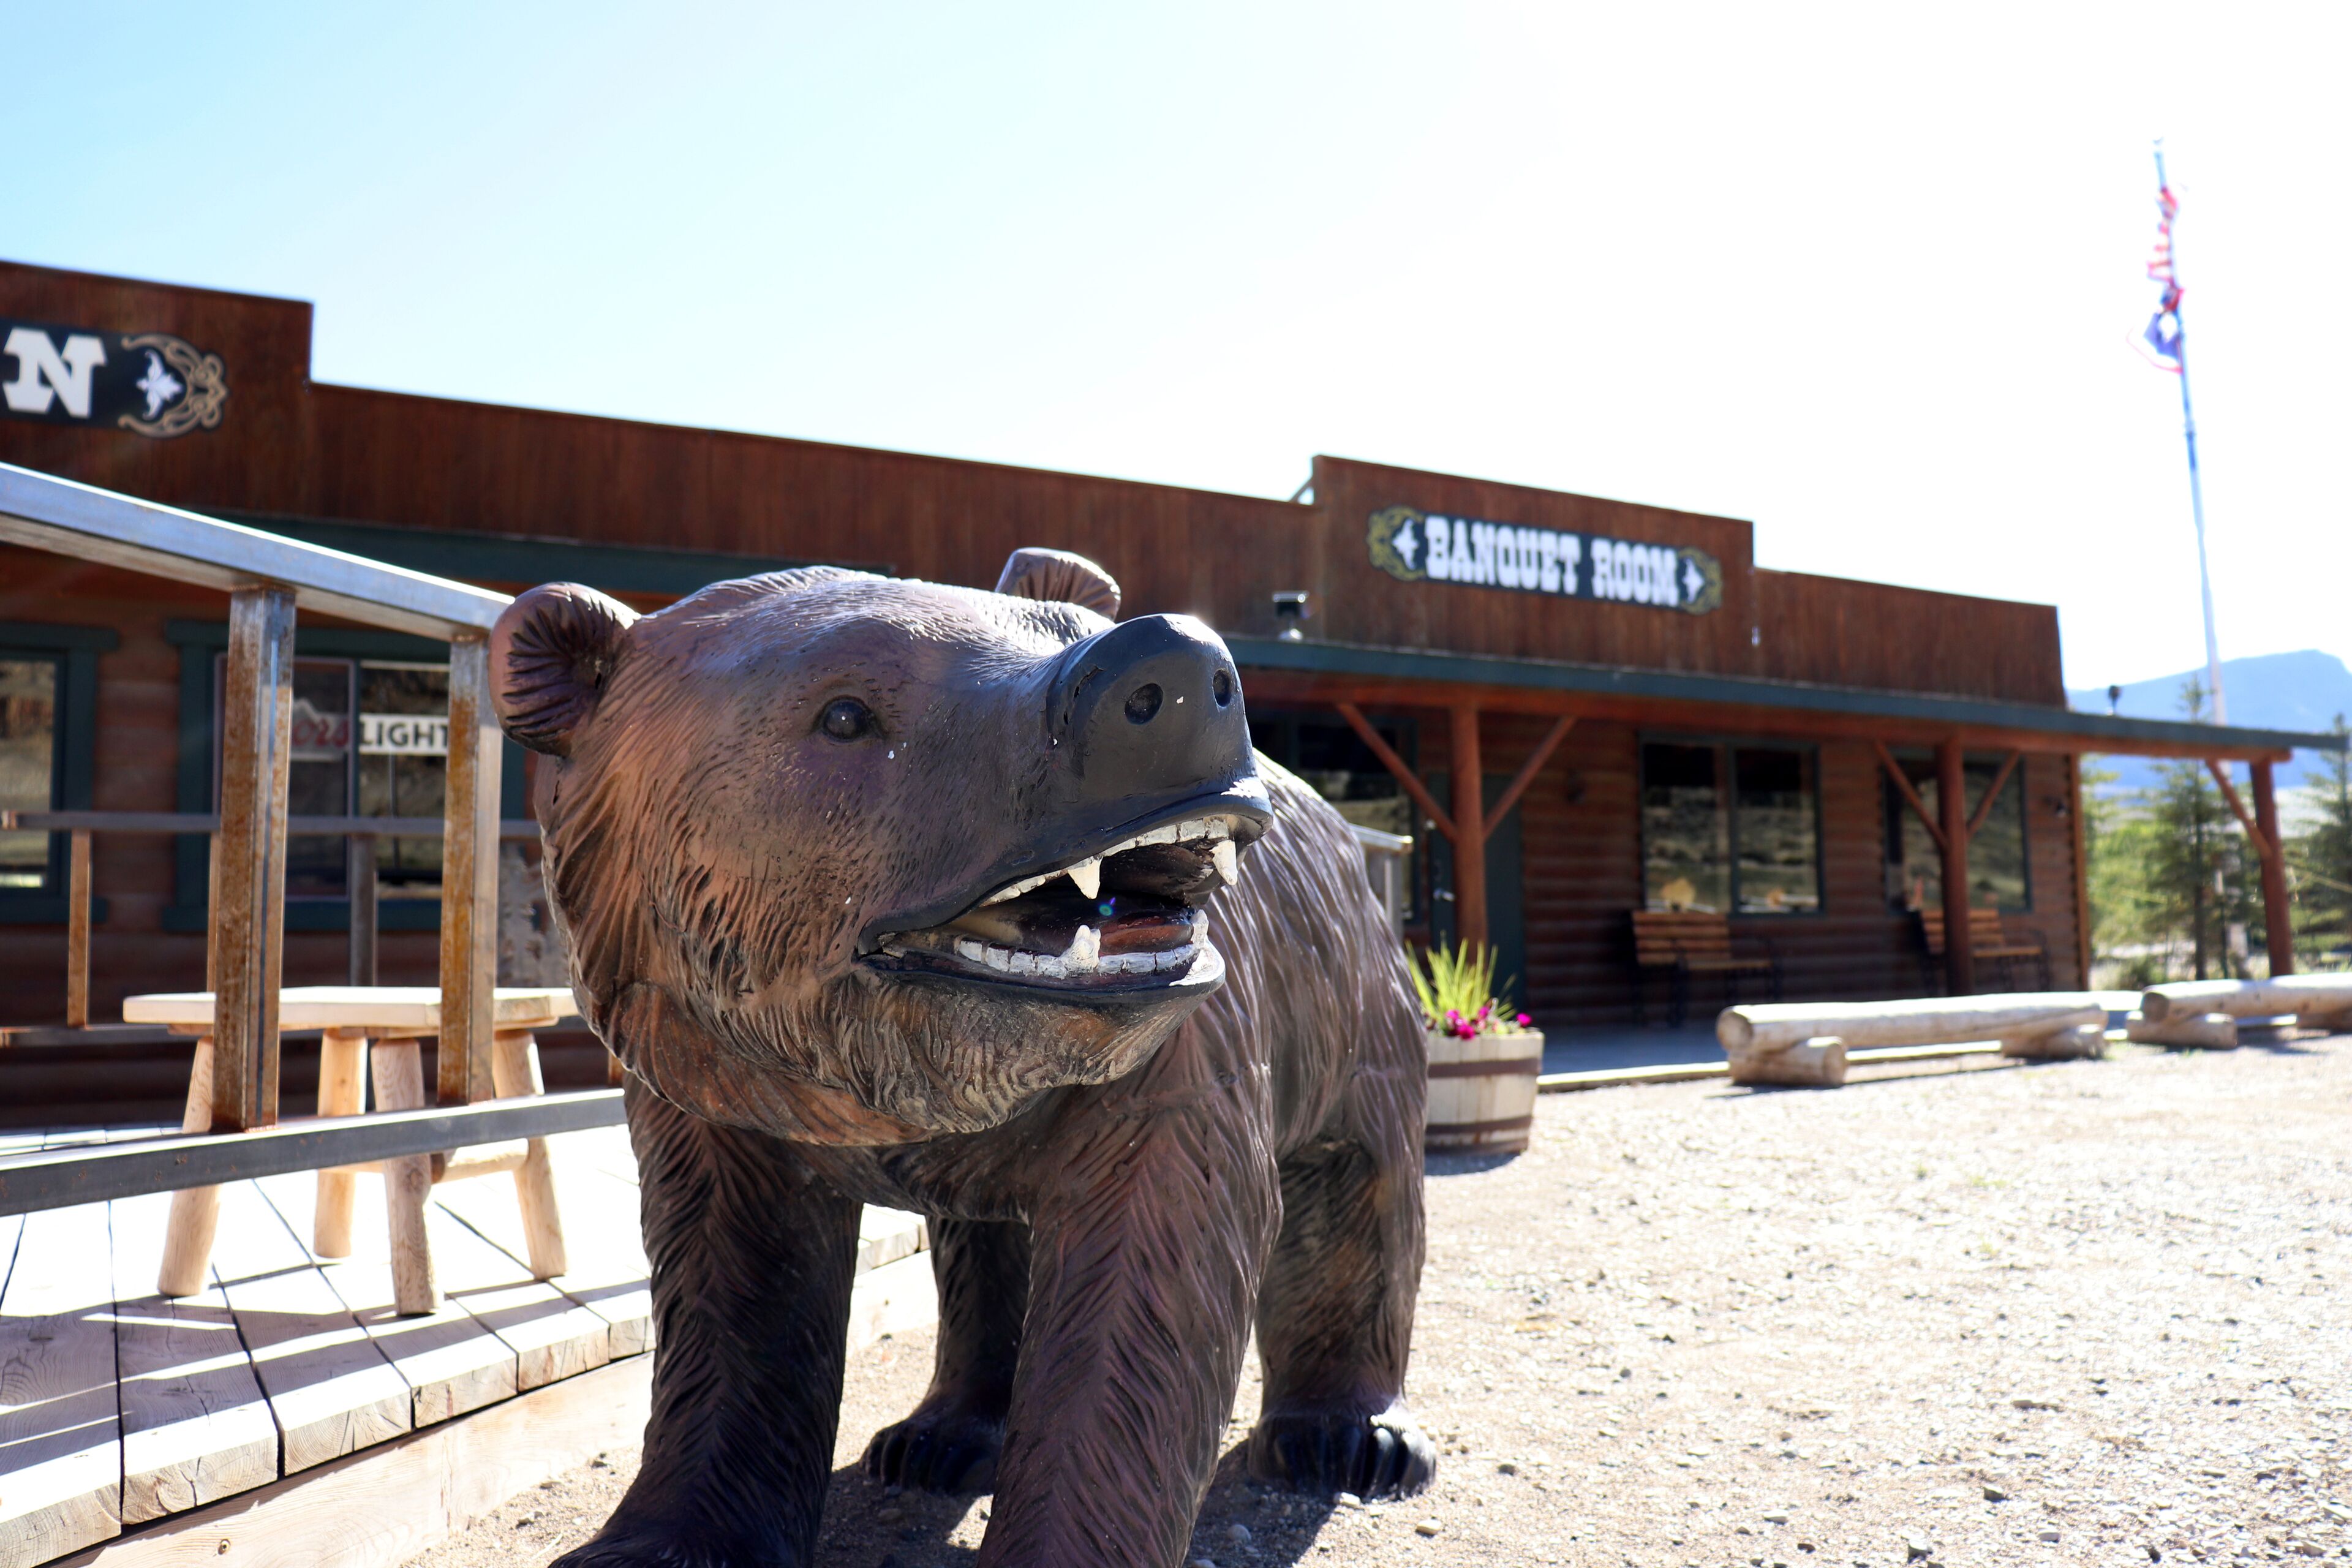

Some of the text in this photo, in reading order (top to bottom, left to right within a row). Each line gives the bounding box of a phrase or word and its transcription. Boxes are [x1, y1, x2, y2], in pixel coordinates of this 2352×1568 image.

[1425, 515, 1678, 606] BANQUET ROOM
[359, 720, 448, 748] LIGHT
